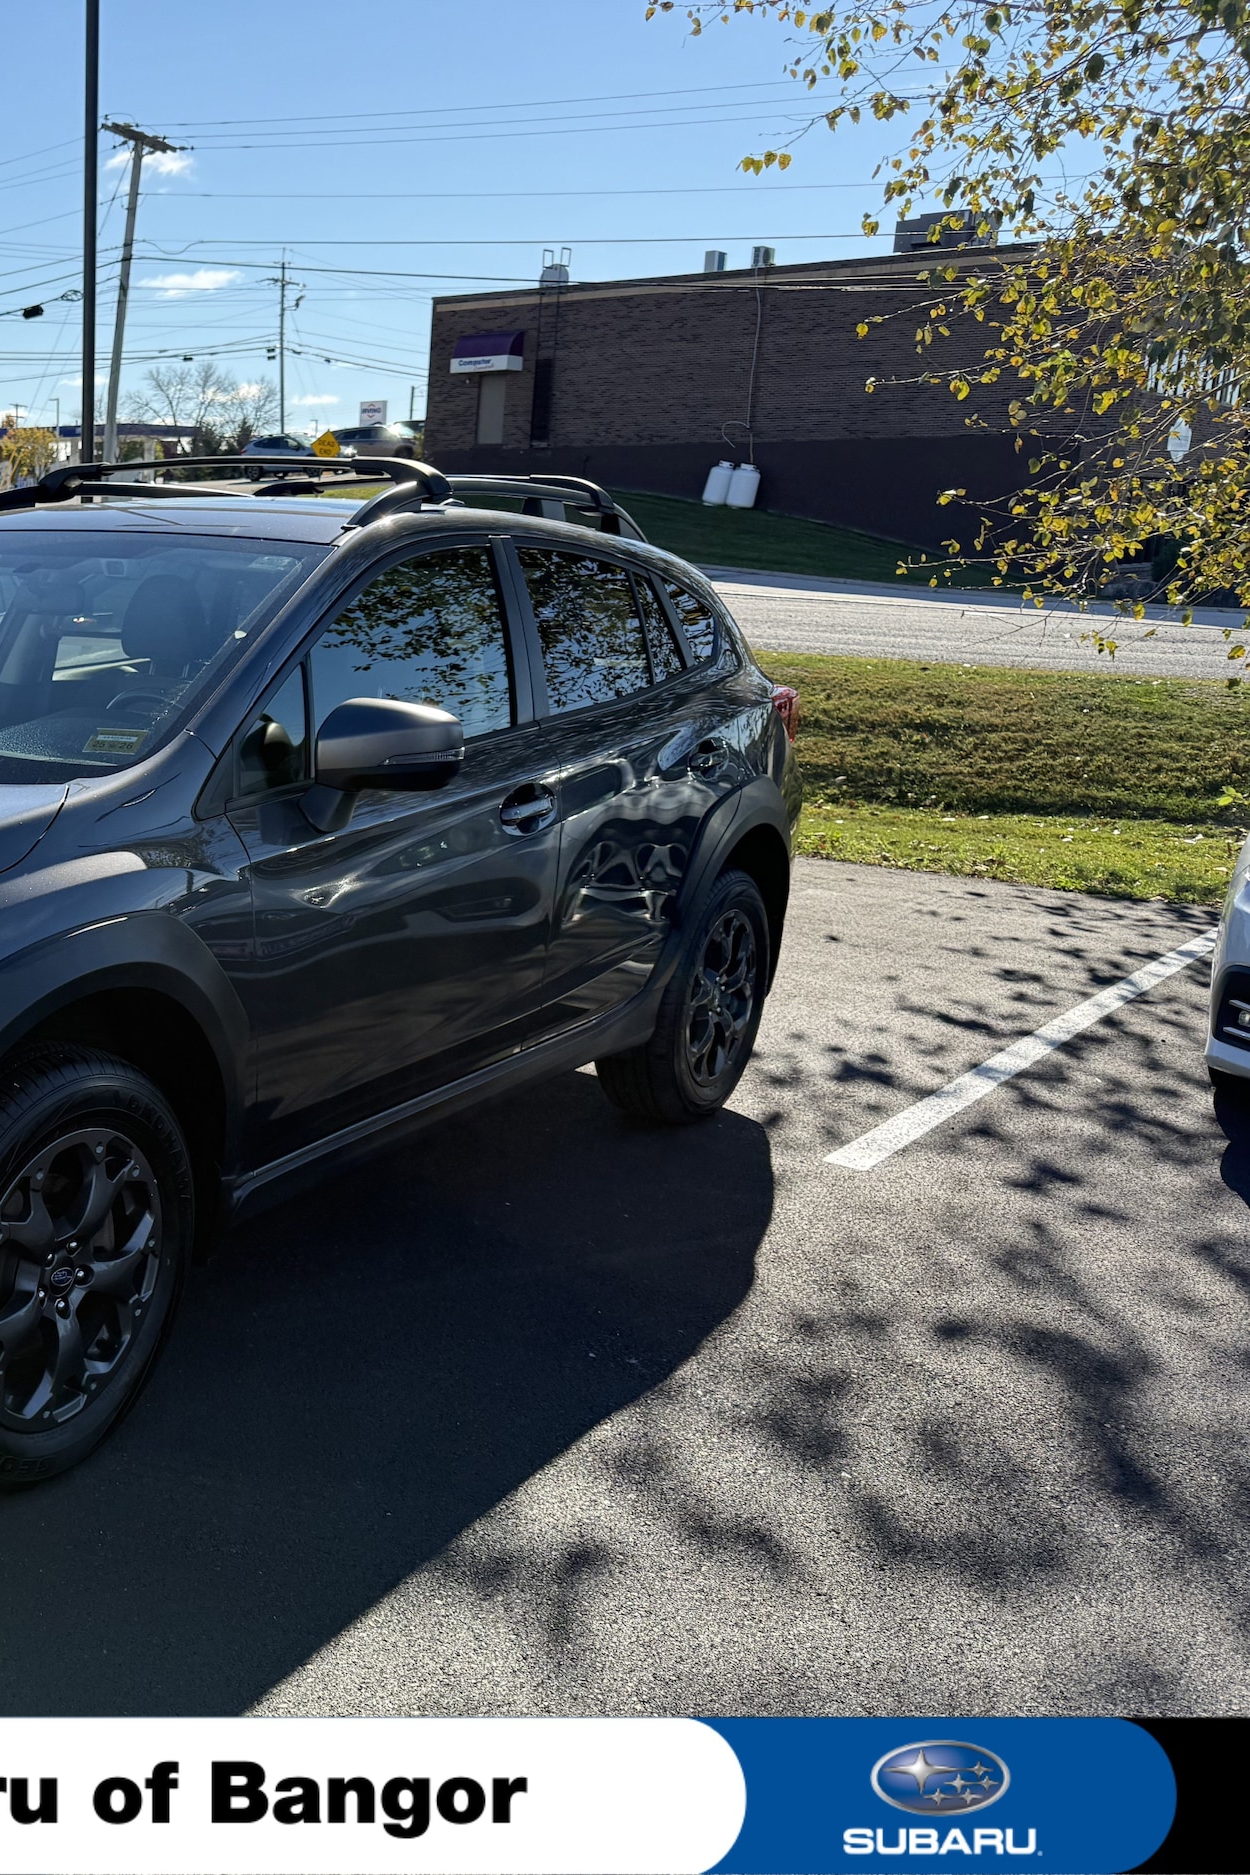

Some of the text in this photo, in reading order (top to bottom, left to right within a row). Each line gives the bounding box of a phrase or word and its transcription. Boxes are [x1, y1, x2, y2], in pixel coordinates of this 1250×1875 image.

[458, 359, 492, 367] Computer
[318, 439, 334, 447] DEAD
[319, 447, 332, 455] END
